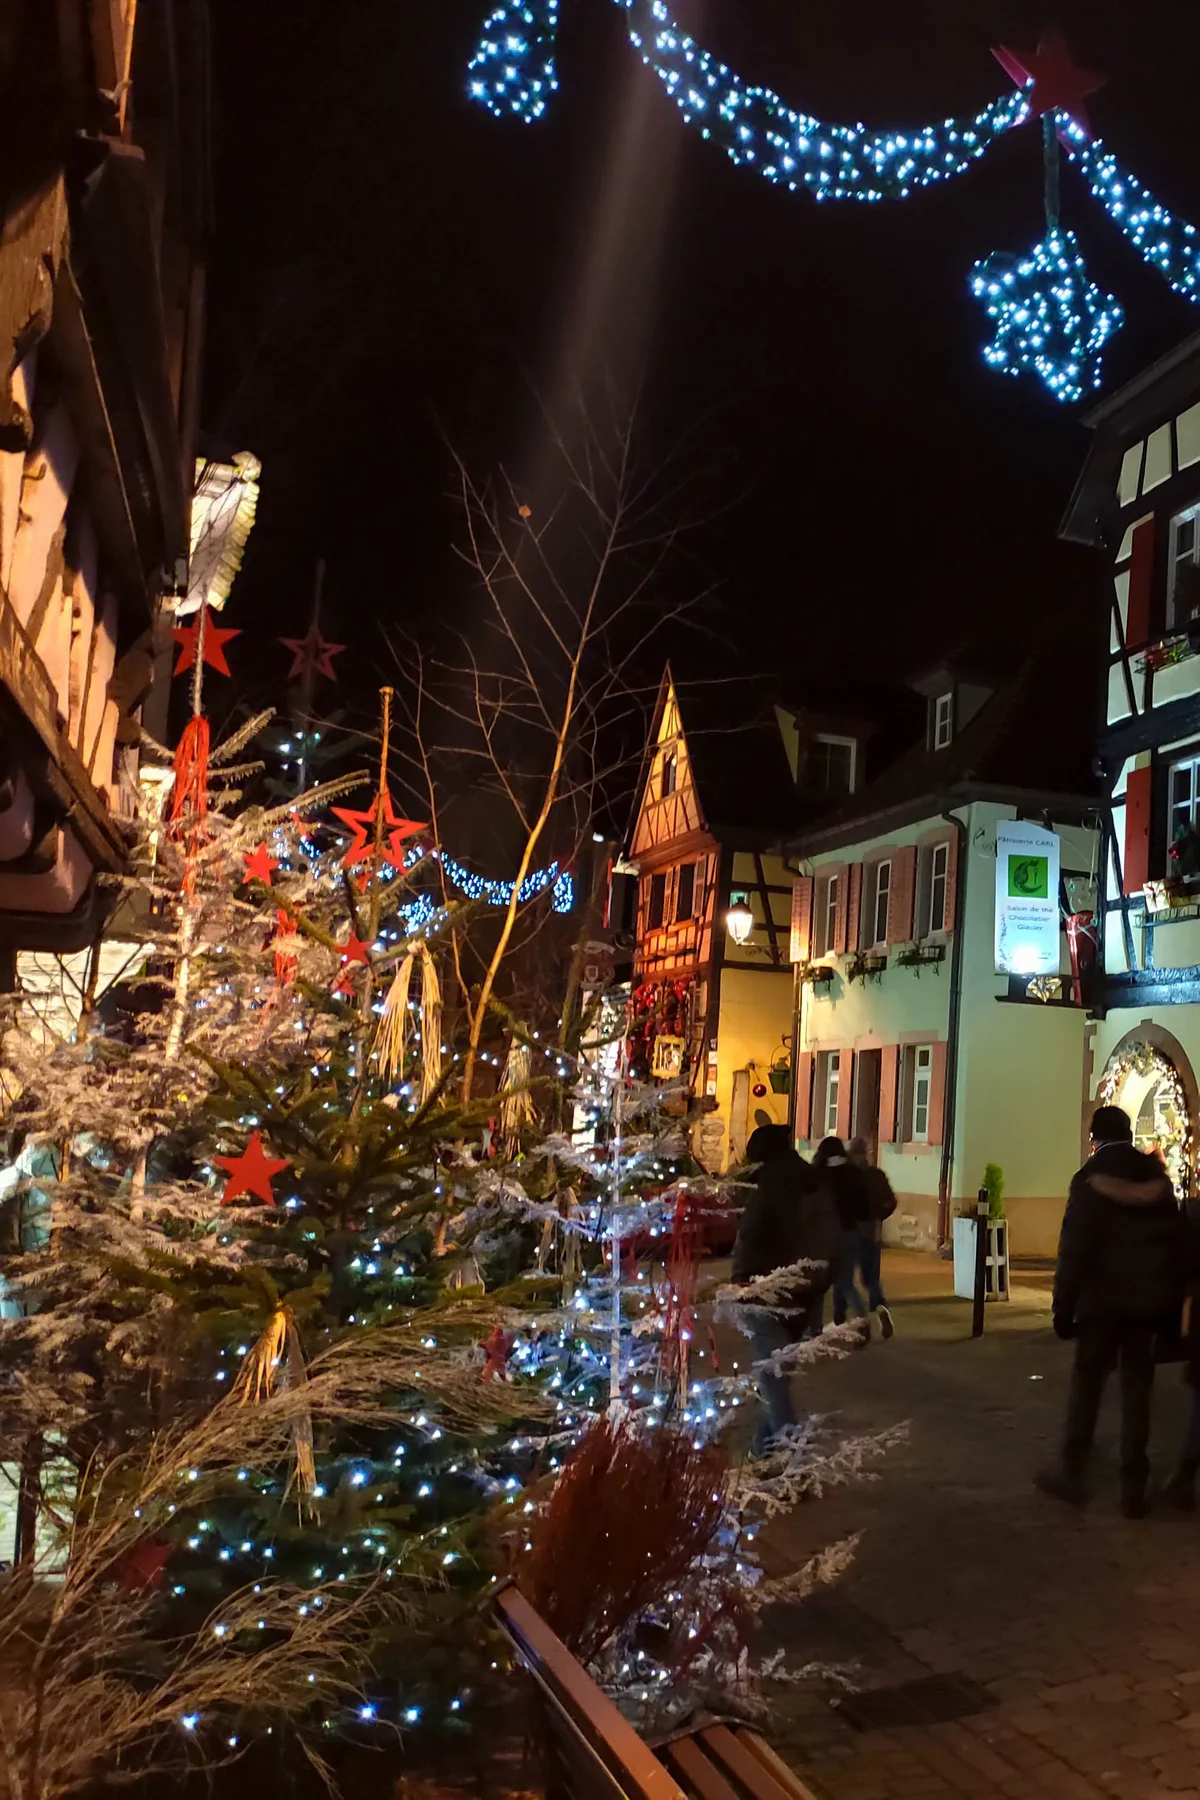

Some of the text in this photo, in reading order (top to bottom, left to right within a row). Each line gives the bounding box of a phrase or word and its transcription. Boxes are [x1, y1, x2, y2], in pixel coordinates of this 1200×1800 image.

[998, 835, 1055, 848] Pâtisserie CARL
[1029, 905, 1039, 913] de
[1008, 914, 1051, 922] Chocolatier
